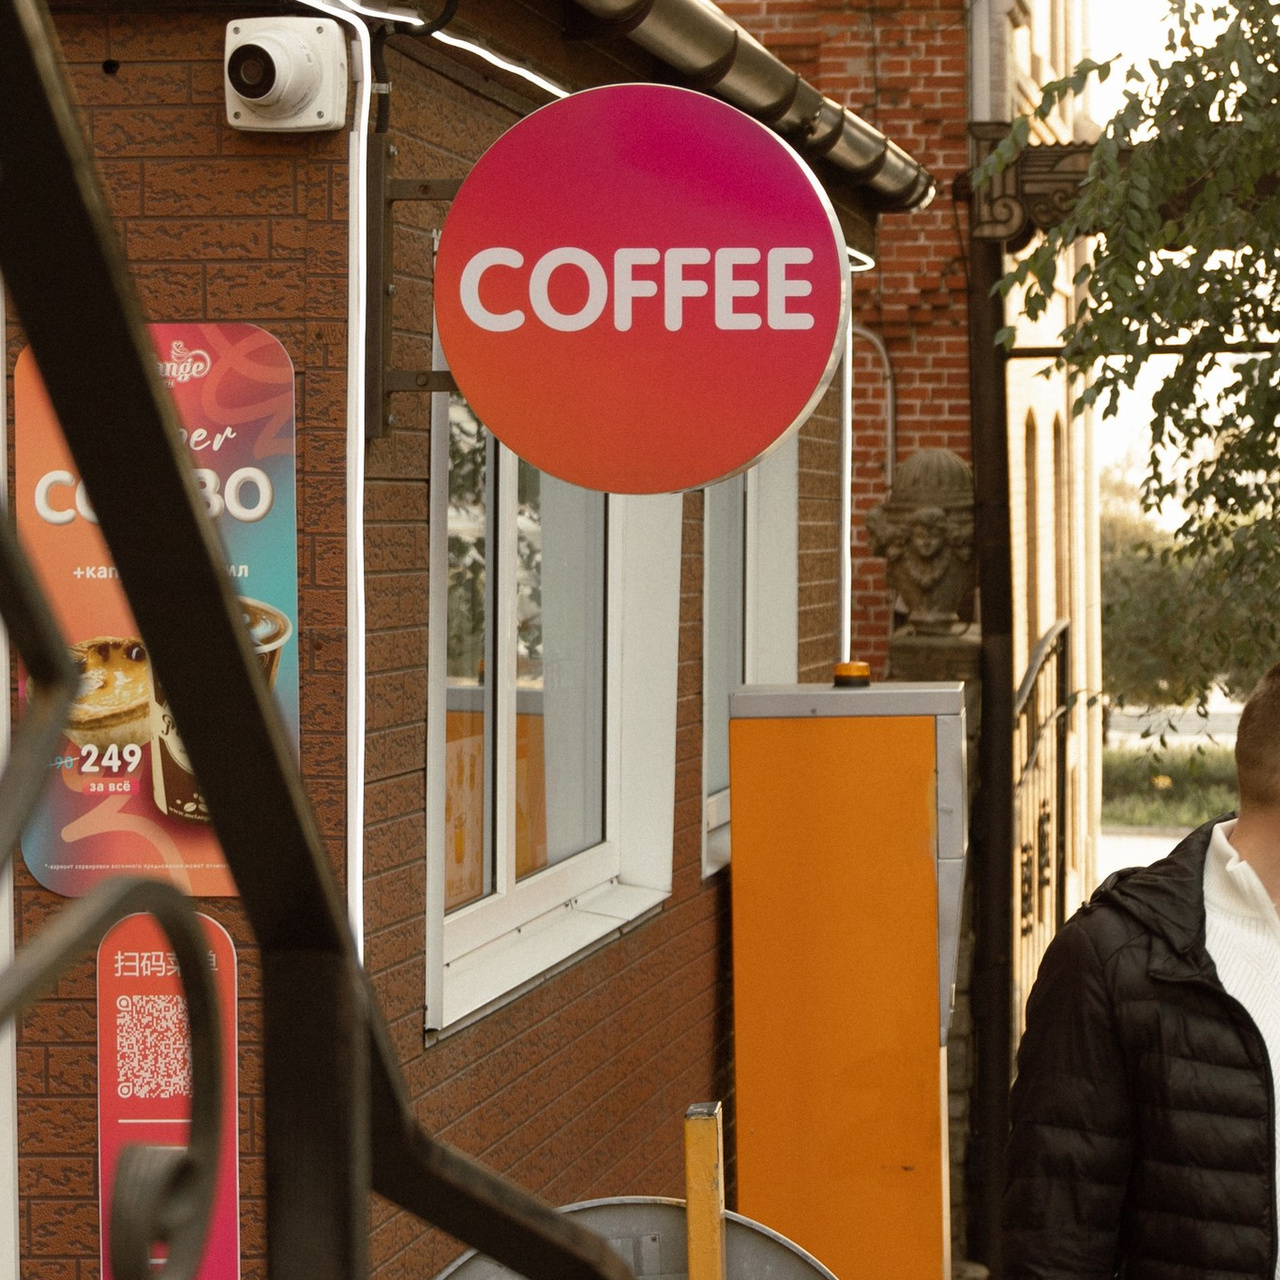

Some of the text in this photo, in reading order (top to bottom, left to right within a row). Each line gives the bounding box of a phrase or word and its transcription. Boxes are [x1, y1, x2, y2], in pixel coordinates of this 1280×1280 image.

[459, 247, 815, 332] COFFEE
[34, 467, 274, 524] CBO
[80, 743, 142, 772] 249
[90, 780, 131, 792] за всё
